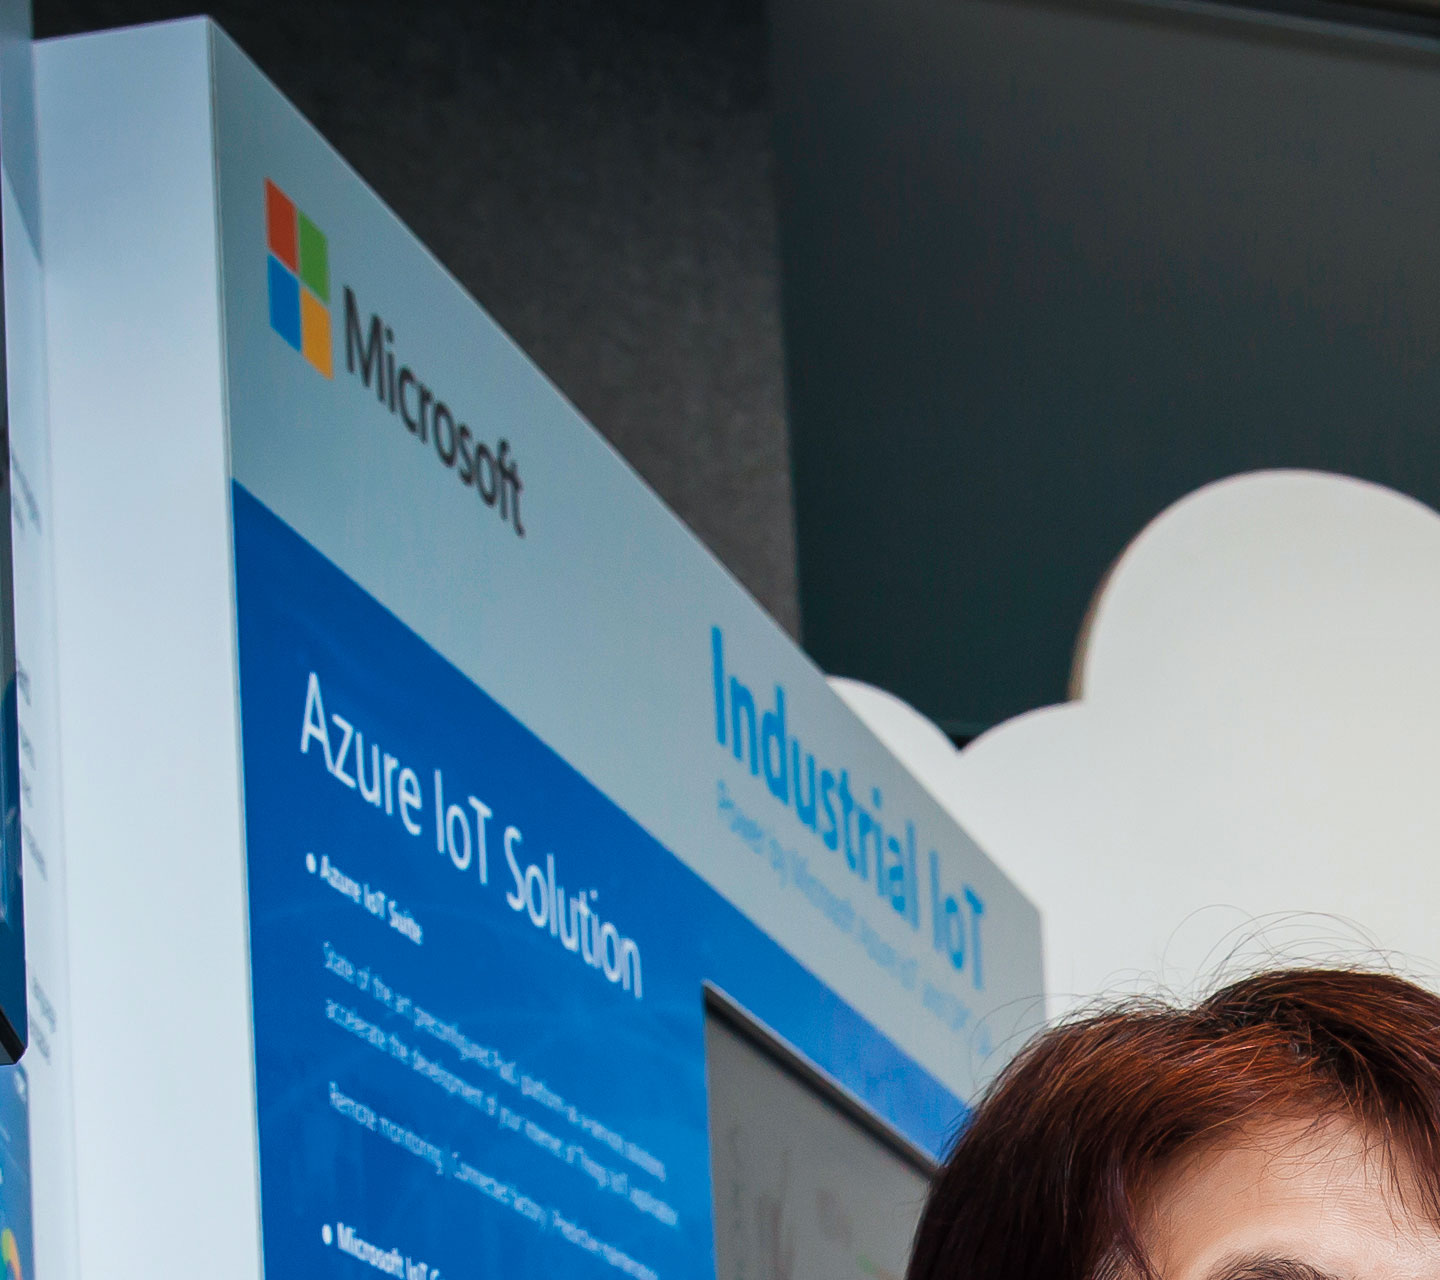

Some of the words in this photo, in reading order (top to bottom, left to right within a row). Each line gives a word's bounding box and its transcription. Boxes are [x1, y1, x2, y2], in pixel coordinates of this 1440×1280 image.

[341, 284, 526, 538] Microsoft
[299, 671, 424, 836] Azure
[433, 769, 492, 884] IoT
[503, 826, 644, 1000] Solution
[709, 624, 921, 931] Industrial
[931, 849, 986, 990] IoT
[337, 1222, 404, 1280] Microsoft
